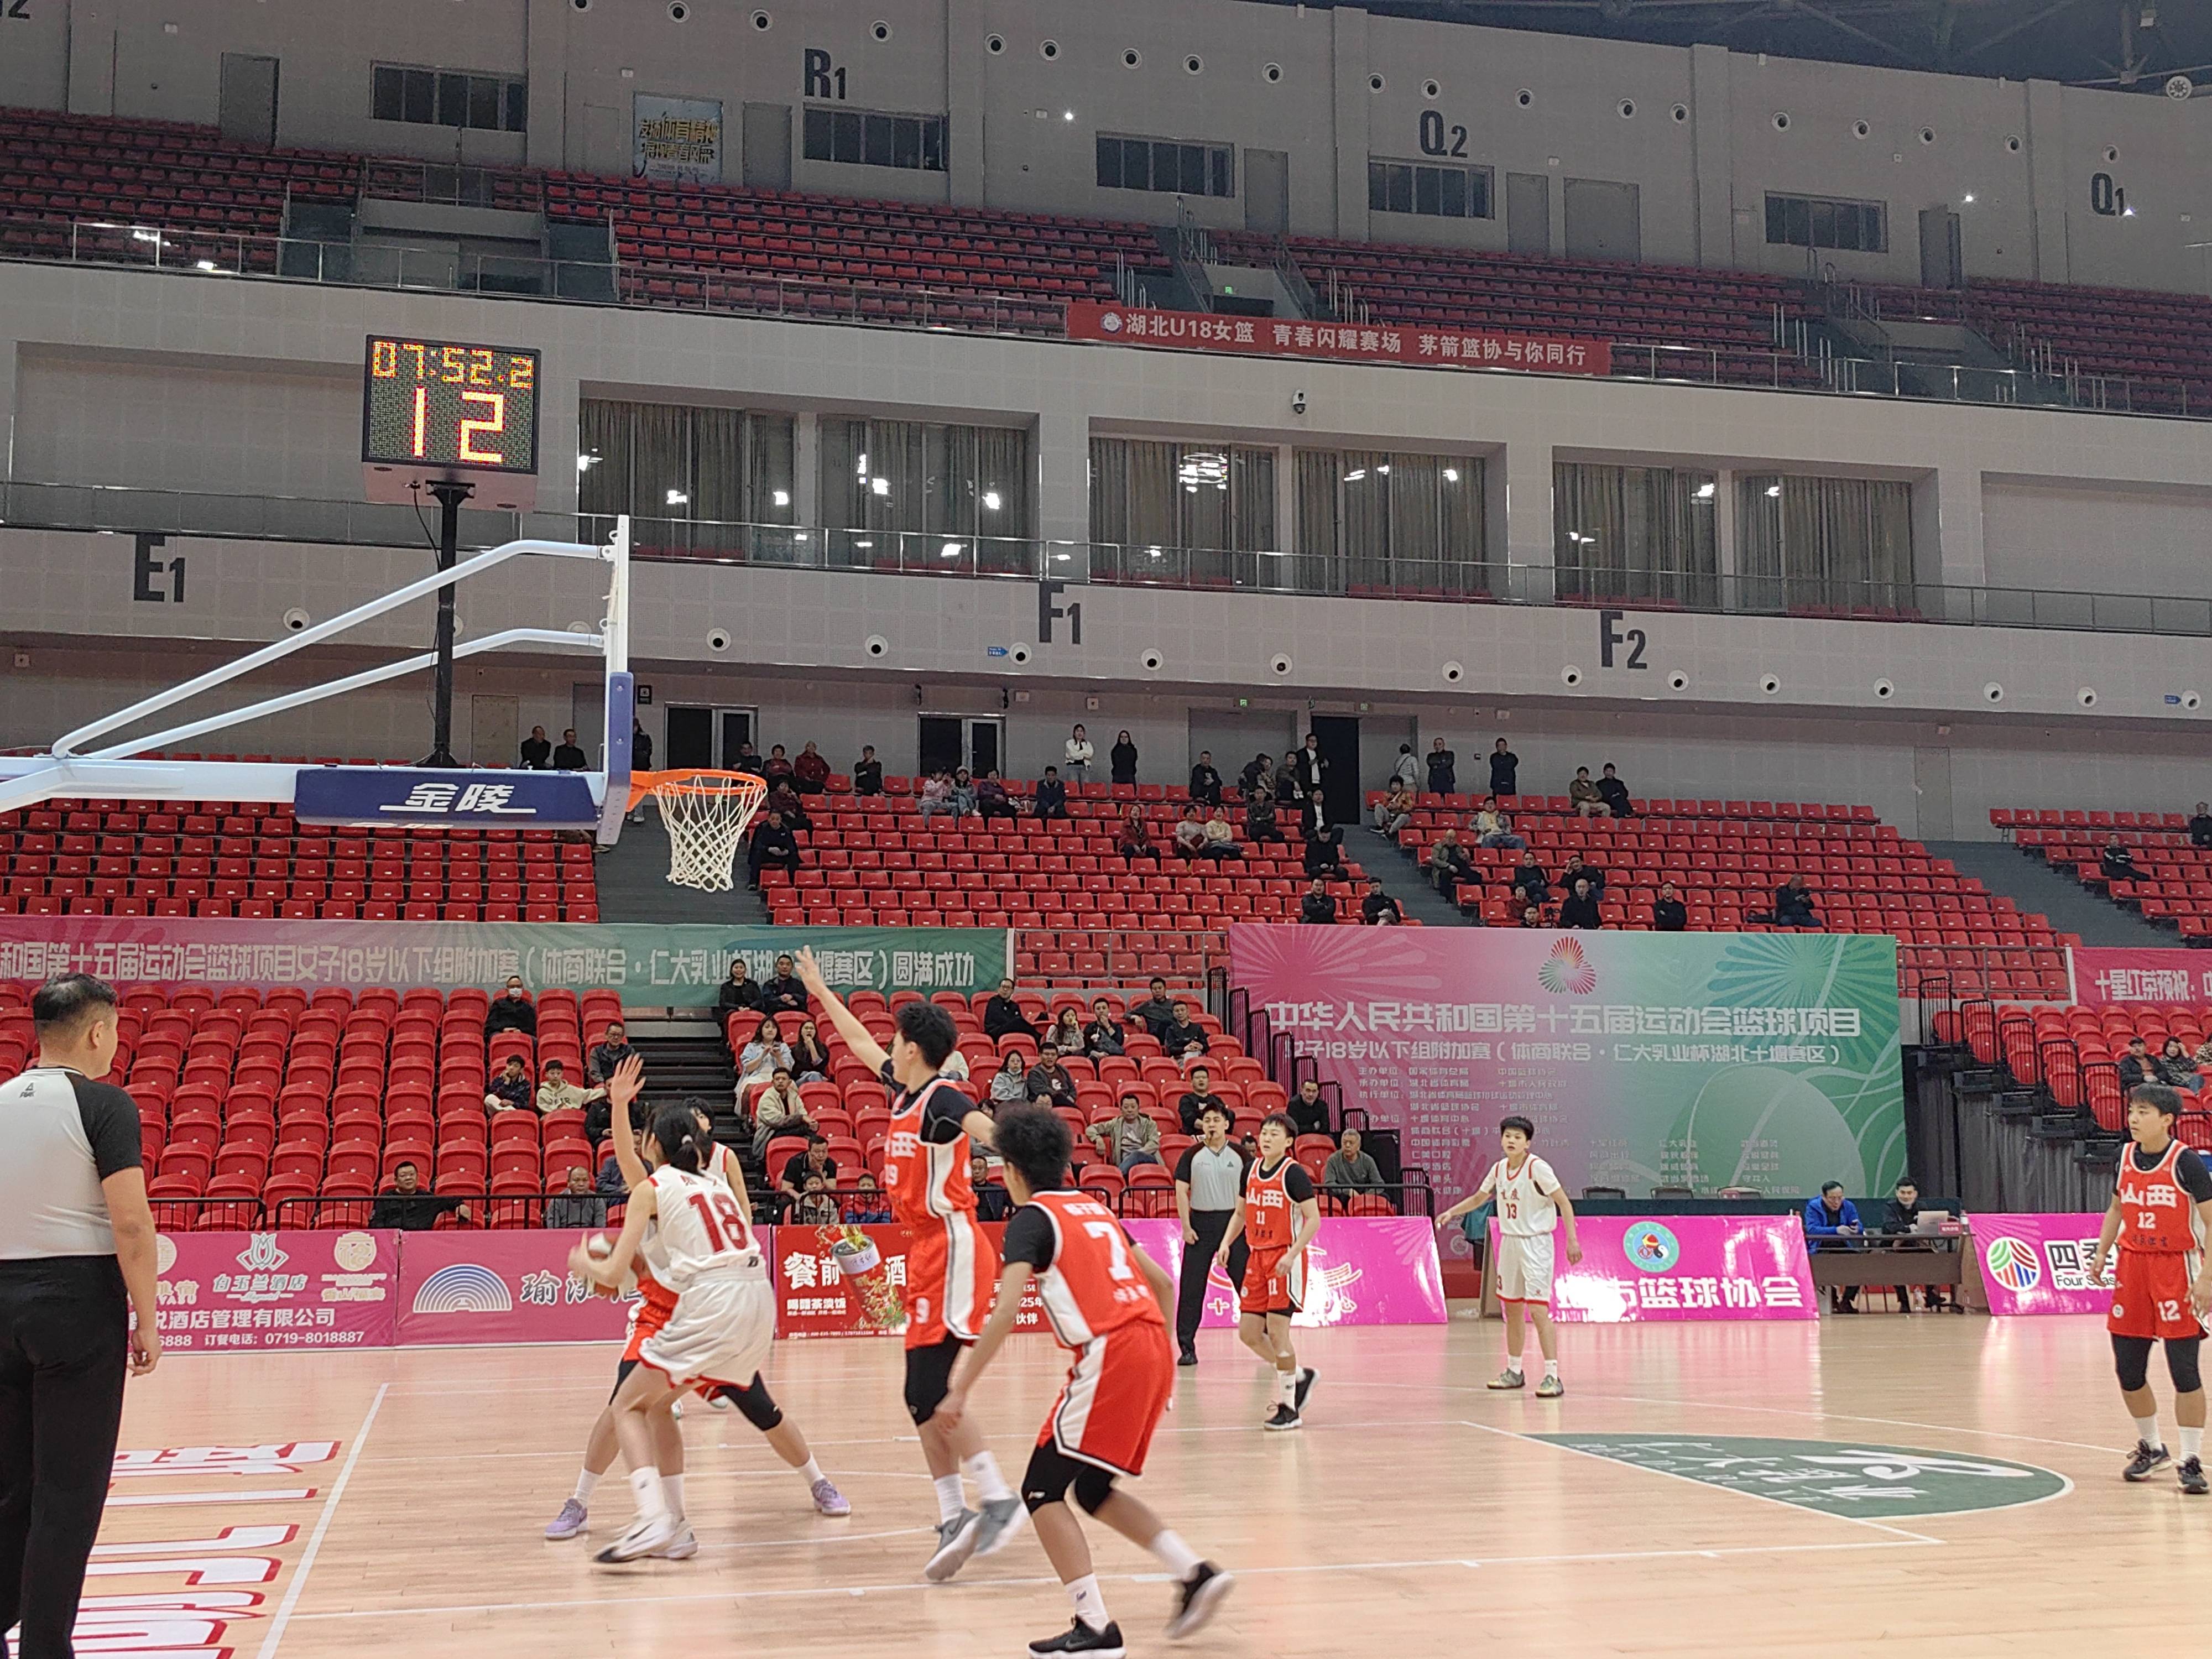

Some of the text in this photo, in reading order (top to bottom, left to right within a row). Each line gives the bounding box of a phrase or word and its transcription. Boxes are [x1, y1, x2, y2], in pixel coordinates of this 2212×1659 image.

[805, 49, 846, 100] R1
[1419, 110, 1468, 157] Q2
[2091, 173, 2125, 216] Q1
[1126, 313, 1585, 366] 湖北U18女篮 青春闪耀赛场 茅箭篮协与你同行
[373, 341, 533, 389] 07:52.2
[134, 533, 185, 602] E1
[1039, 581, 1081, 645] F1
[1600, 611, 1647, 669] F2
[379, 783, 536, 813] 金陵
[1265, 1001, 1860, 1037] 中华人民共和国第十五届运动会篮球项目
[1246, 1187, 1284, 1209] 山西
[1506, 1203, 1517, 1219] 13
[2121, 1182, 2177, 1208] 山西
[687, 1191, 748, 1254] 18
[1256, 1211, 1265, 1225] 11
[2137, 1212, 2156, 1228] 12
[1082, 1221, 1134, 1281] 7
[213, 1274, 308, 1292] 白玉兰酒店
[1267, 1278, 1277, 1295] 11
[2056, 1275, 2083, 1286] Four
[2158, 1300, 2182, 1322] 12
[264, 1331, 365, 1345] 0719-8018887
